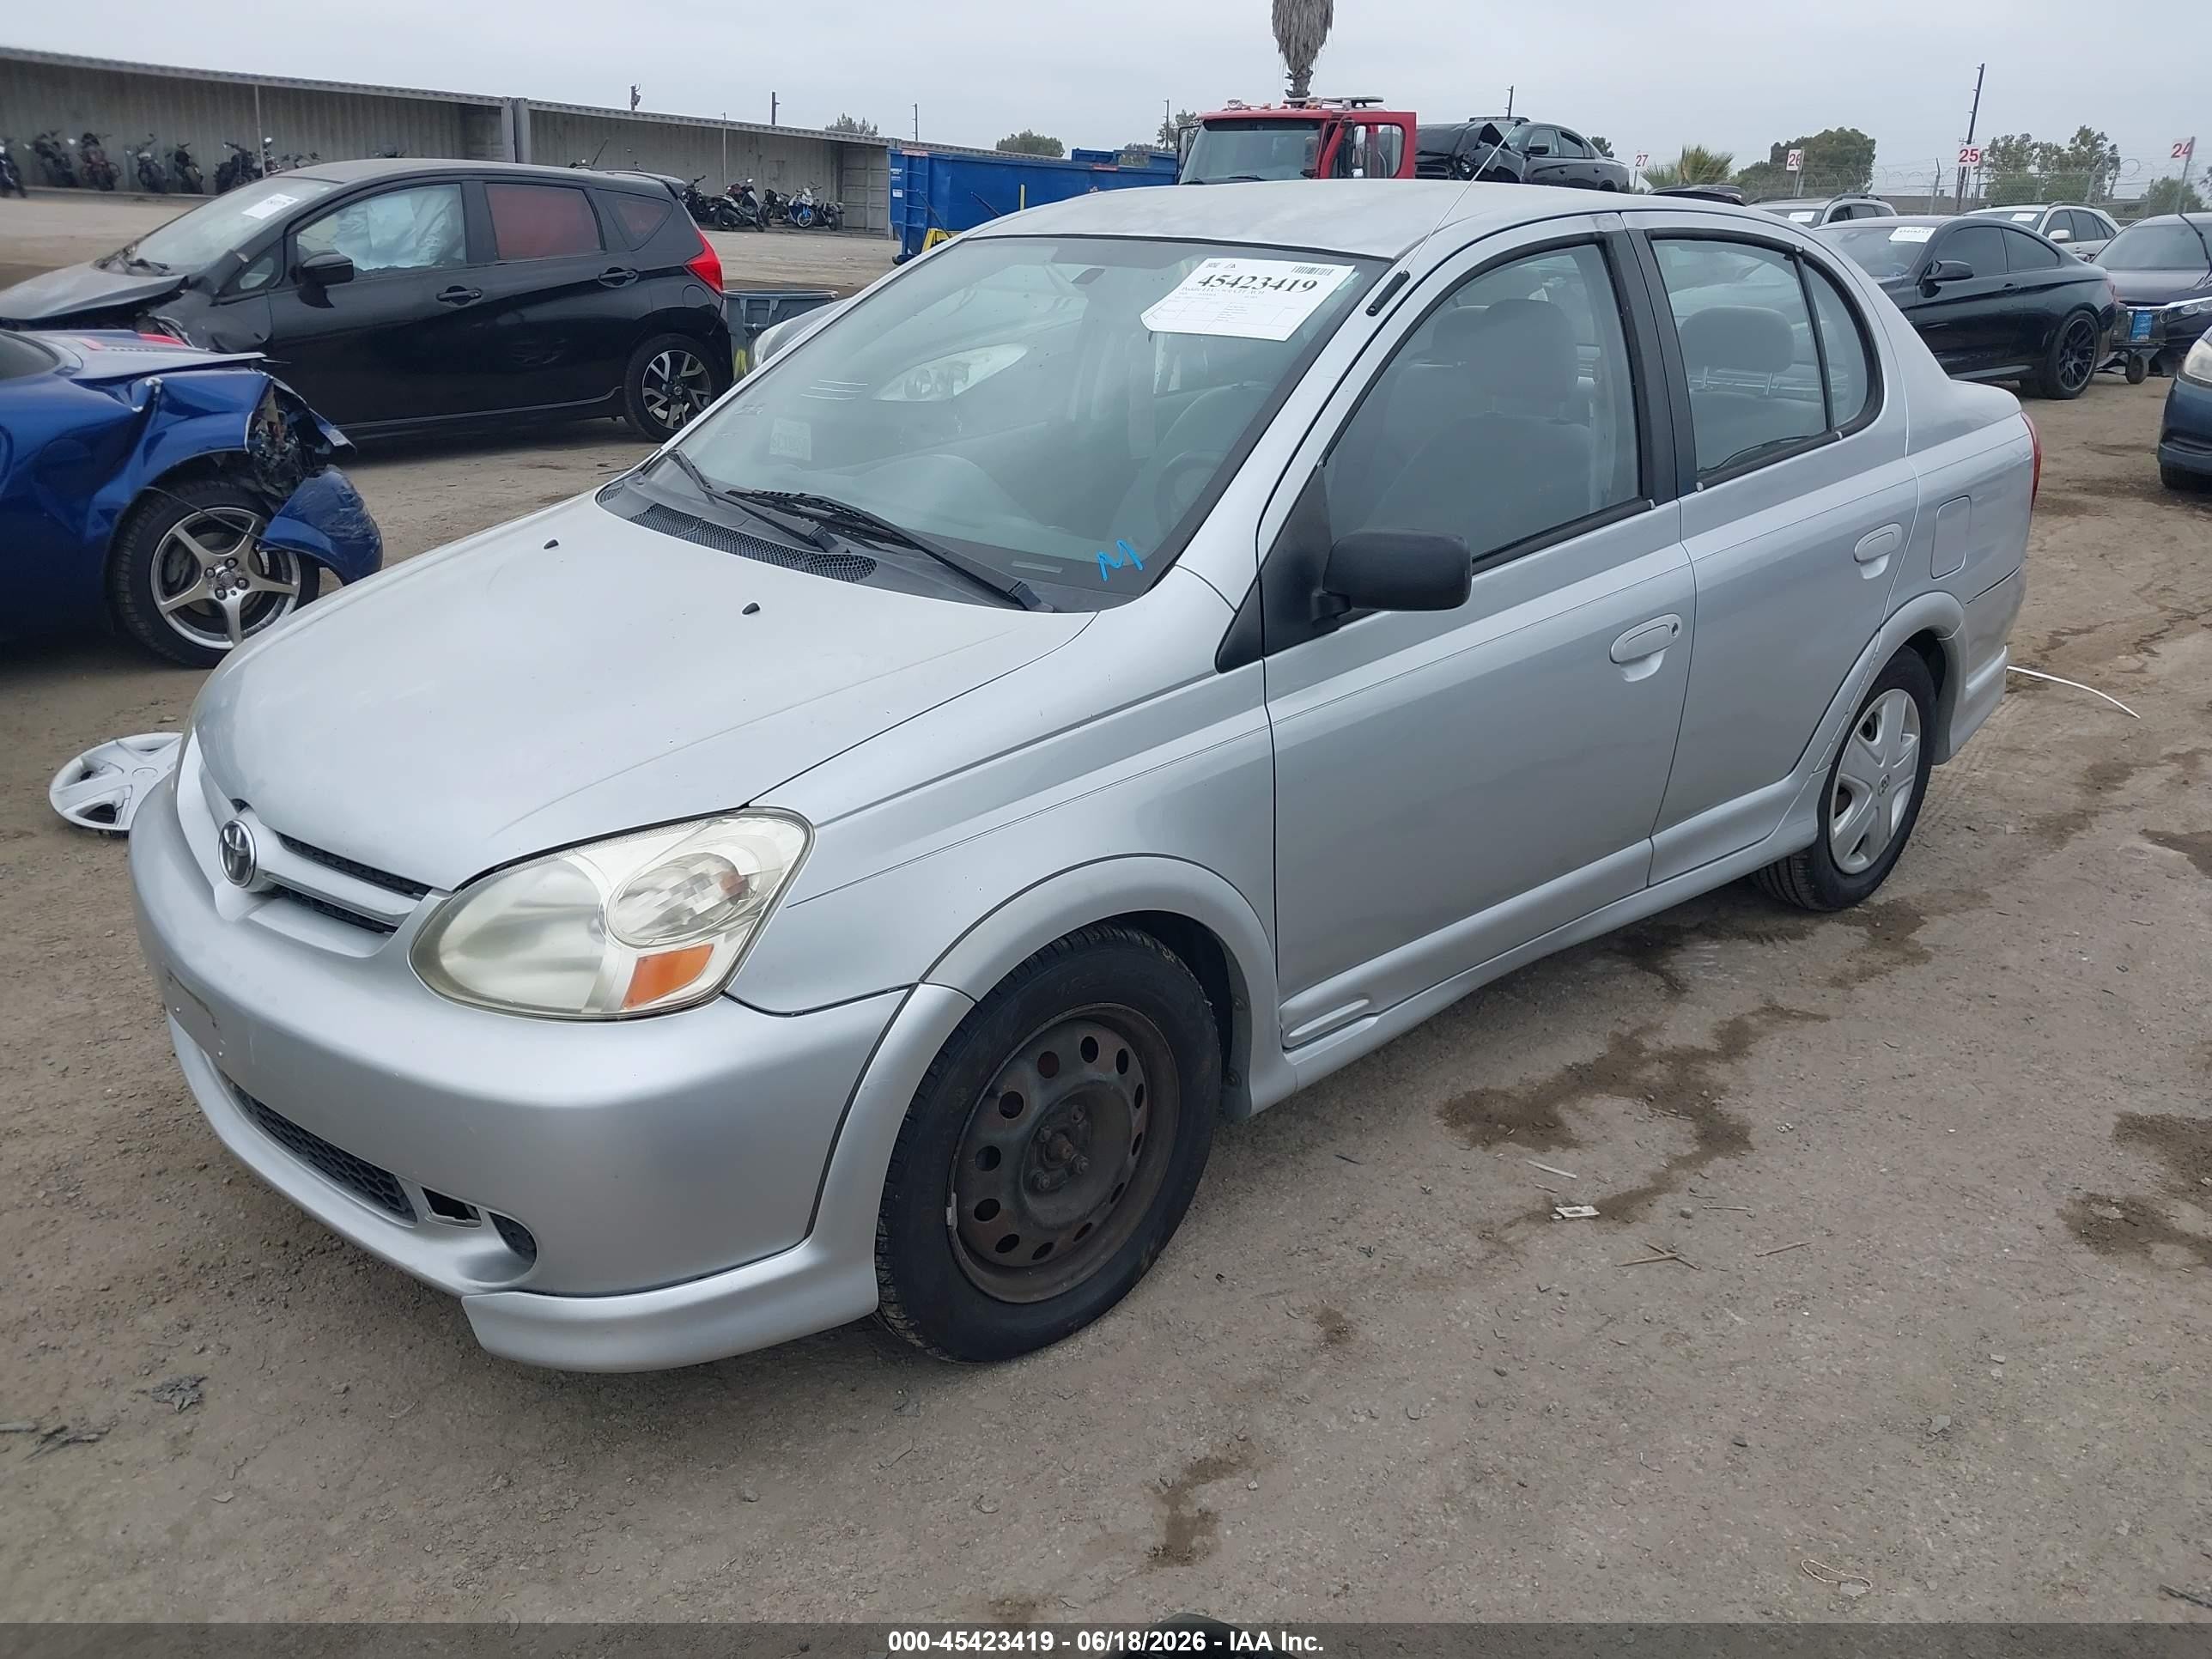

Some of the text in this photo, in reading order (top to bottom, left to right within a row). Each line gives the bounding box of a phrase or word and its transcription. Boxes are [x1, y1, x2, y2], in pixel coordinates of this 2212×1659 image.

[1635, 155, 1649, 167] 27
[1959, 149, 1979, 162] 25
[1197, 274, 1318, 293] 45423419
